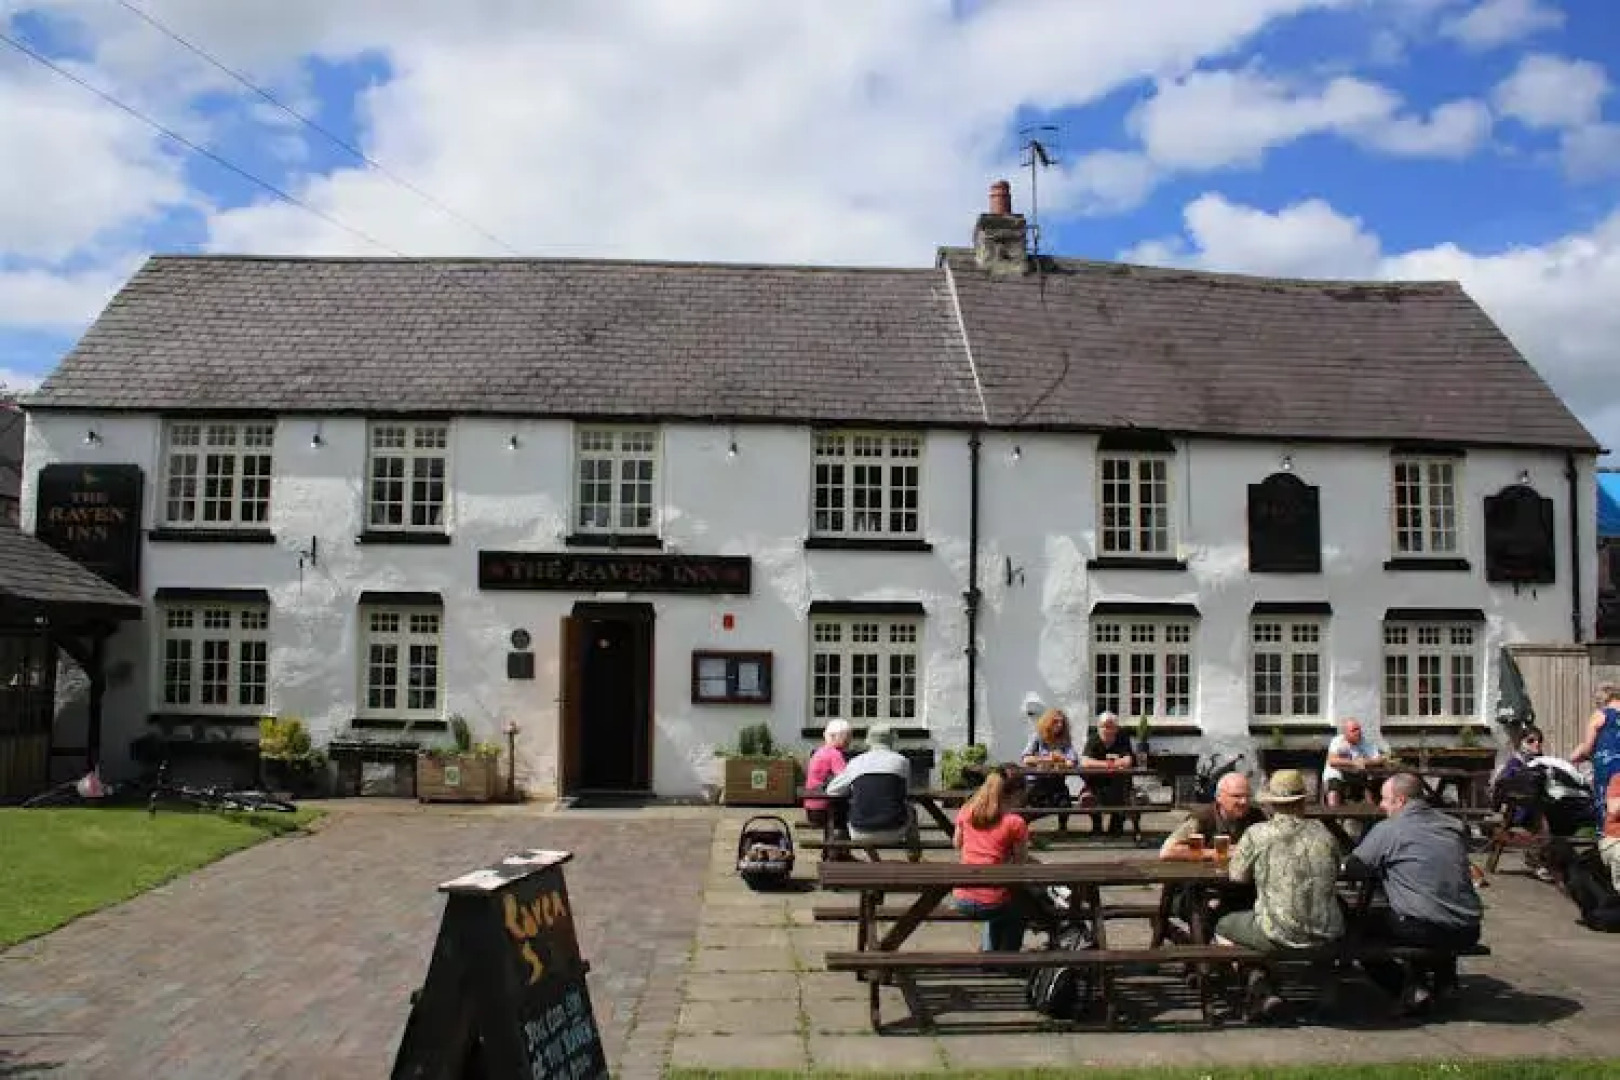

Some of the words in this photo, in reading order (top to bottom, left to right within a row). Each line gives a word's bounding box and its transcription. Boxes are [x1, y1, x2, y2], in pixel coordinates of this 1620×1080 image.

[51, 507, 124, 523] RAVEN
[67, 526, 107, 540] INN
[507, 561, 562, 580] THE
[567, 561, 661, 581] RAVEN
[672, 564, 718, 581] INN
